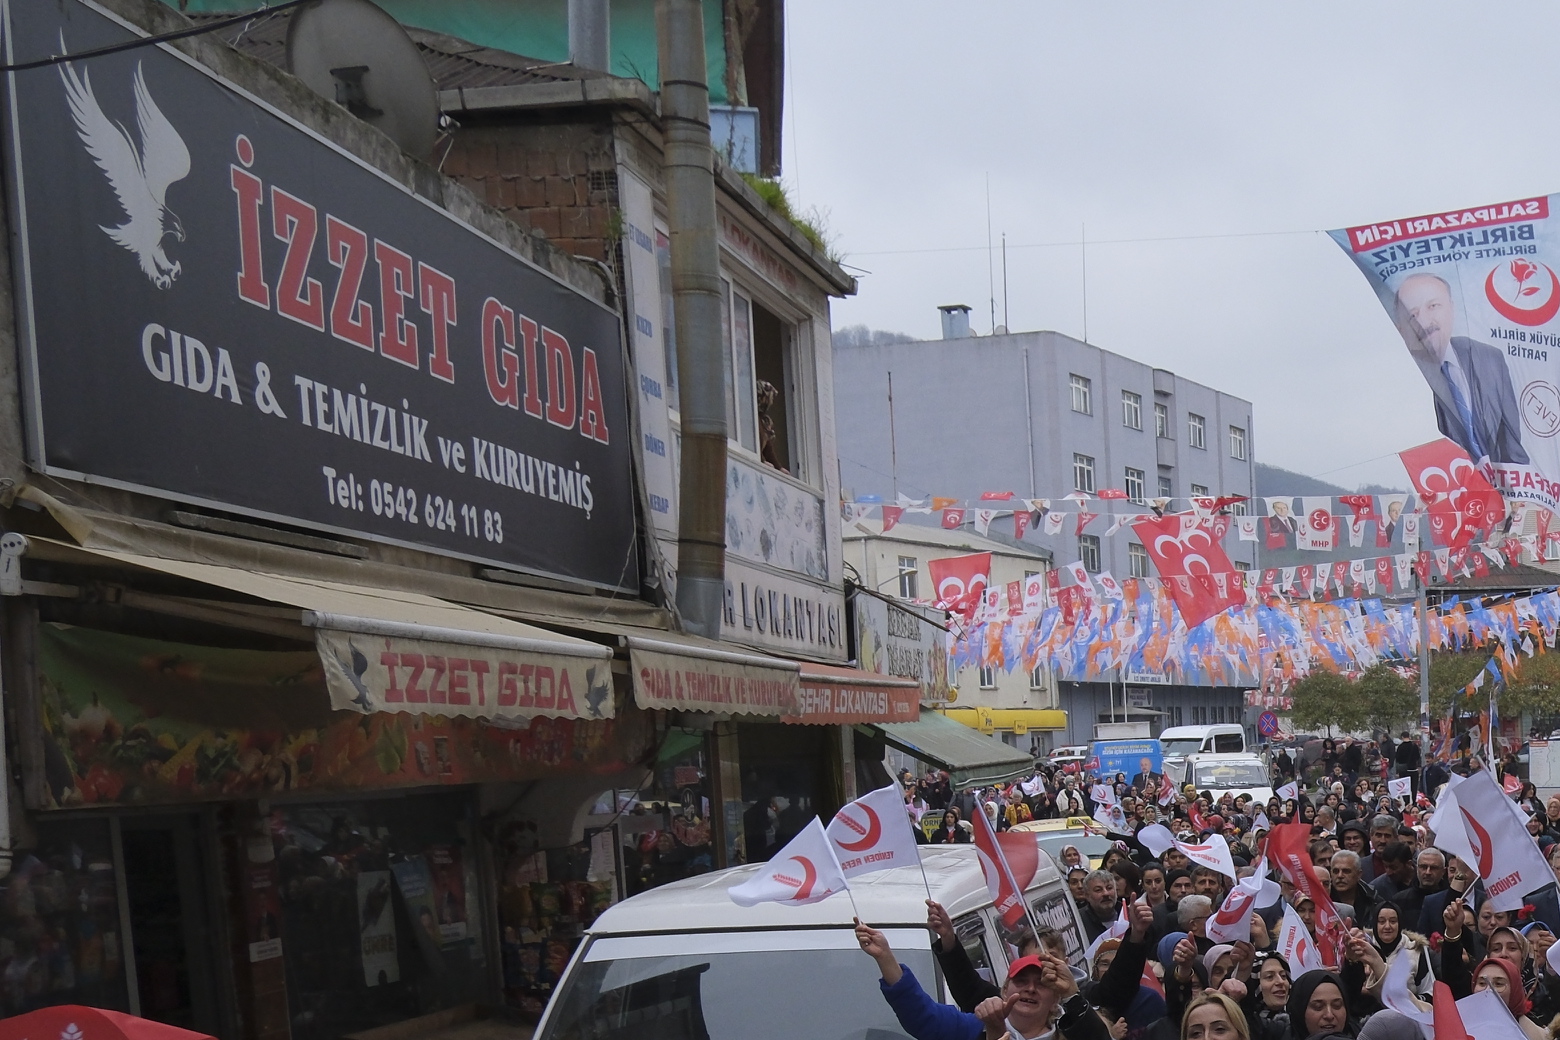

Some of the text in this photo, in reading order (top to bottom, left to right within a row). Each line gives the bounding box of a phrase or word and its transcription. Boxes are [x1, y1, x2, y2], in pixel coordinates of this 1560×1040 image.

[231, 134, 609, 445] İZZET GIDA
[142, 323, 594, 520] GIDA & TEMİZLİK ve KURUYEMİŞ
[323, 466, 503, 543] Tel: 0542 624 11 83
[741, 581, 843, 649] LOKANTASI
[380, 638, 578, 715] İZZET GIDA
[641, 667, 672, 699] GIDA
[685, 666, 732, 703] TEMİZLİK
[834, 690, 888, 716] LOKANTASI
